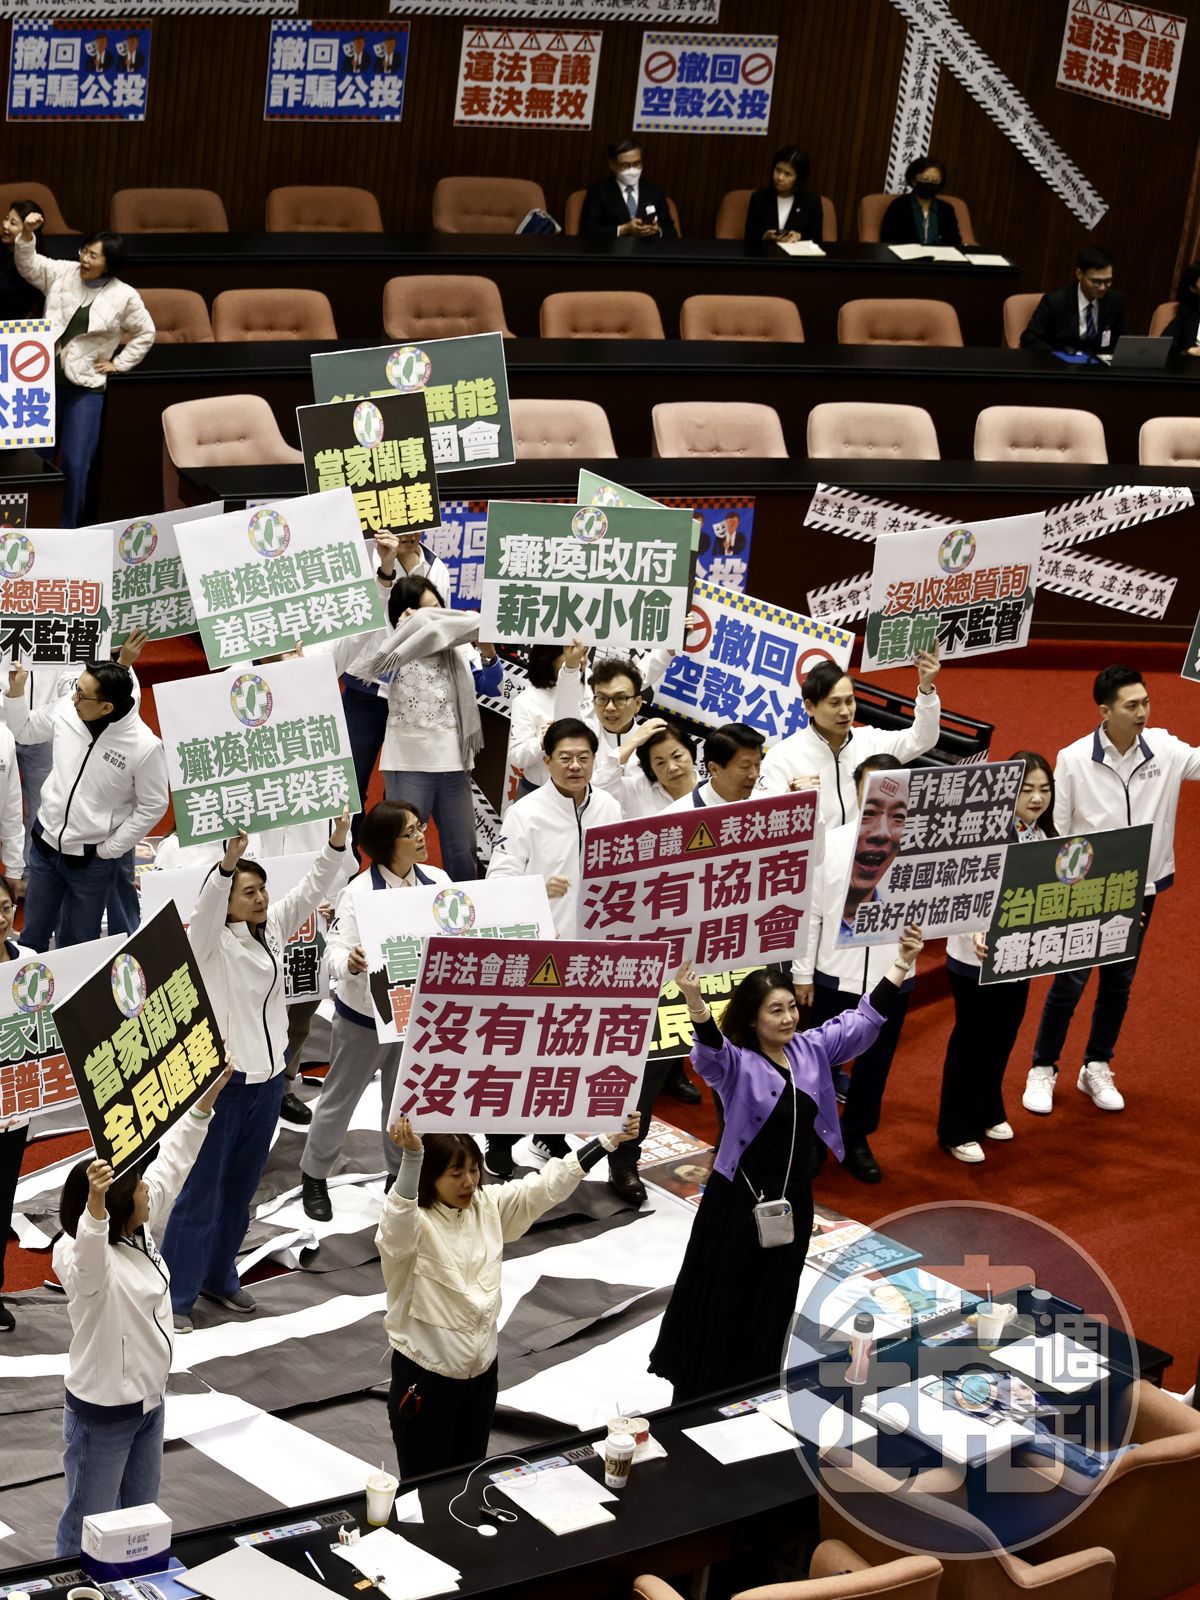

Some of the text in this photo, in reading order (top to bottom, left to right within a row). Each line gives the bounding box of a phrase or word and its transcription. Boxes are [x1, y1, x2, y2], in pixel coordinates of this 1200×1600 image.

[13, 36, 82, 71] 撤回
[270, 35, 341, 71] 撤回
[463, 50, 592, 86] 違法會議
[677, 51, 742, 86] 撤回
[1067, 14, 1176, 75] 違法會議
[11, 74, 147, 108] 詐騙公投
[268, 73, 402, 109] 詐騙公投
[460, 86, 589, 120] 表決無效
[640, 86, 768, 121] 空殼公投
[1062, 50, 1171, 108] 表決無效
[314, 436, 427, 489] 當家鬧事
[354, 483, 434, 532] 民唾棄
[810, 498, 878, 531] 違法會議
[200, 539, 363, 611] 癱瘓總質詢
[497, 533, 678, 584] 癱瘓政府
[496, 582, 673, 643] 薪水小偷
[885, 563, 1030, 616] 沒收總質詢
[1100, 569, 1168, 608] 違法會議
[212, 585, 376, 660] 羞辱卓榮泰
[875, 601, 1025, 668] 護航不監督
[708, 614, 799, 688] 撤回
[177, 712, 342, 779] 癱瘓總質詢
[185, 763, 351, 838] 羞辱卓榮泰
[907, 764, 1022, 813] 詐騙公投
[586, 803, 815, 871] 非法會議 表決無效
[900, 805, 1013, 852] 表決無效
[583, 849, 810, 930] 沒有協商
[888, 852, 1002, 894] 韓國瑜院長
[998, 867, 1139, 929] 治國無能
[600, 903, 805, 971] 有開會
[855, 889, 995, 935] 說好的協商呢
[425, 951, 530, 988] 非法會議
[564, 953, 664, 990] 表決無效
[991, 914, 1134, 976] 癱瘓國會
[83, 962, 200, 1104] 當家鬧事
[411, 1000, 652, 1057] 沒有協商
[103, 1016, 221, 1168] 全民唾棄
[399, 1062, 638, 1119] 沒有開會
